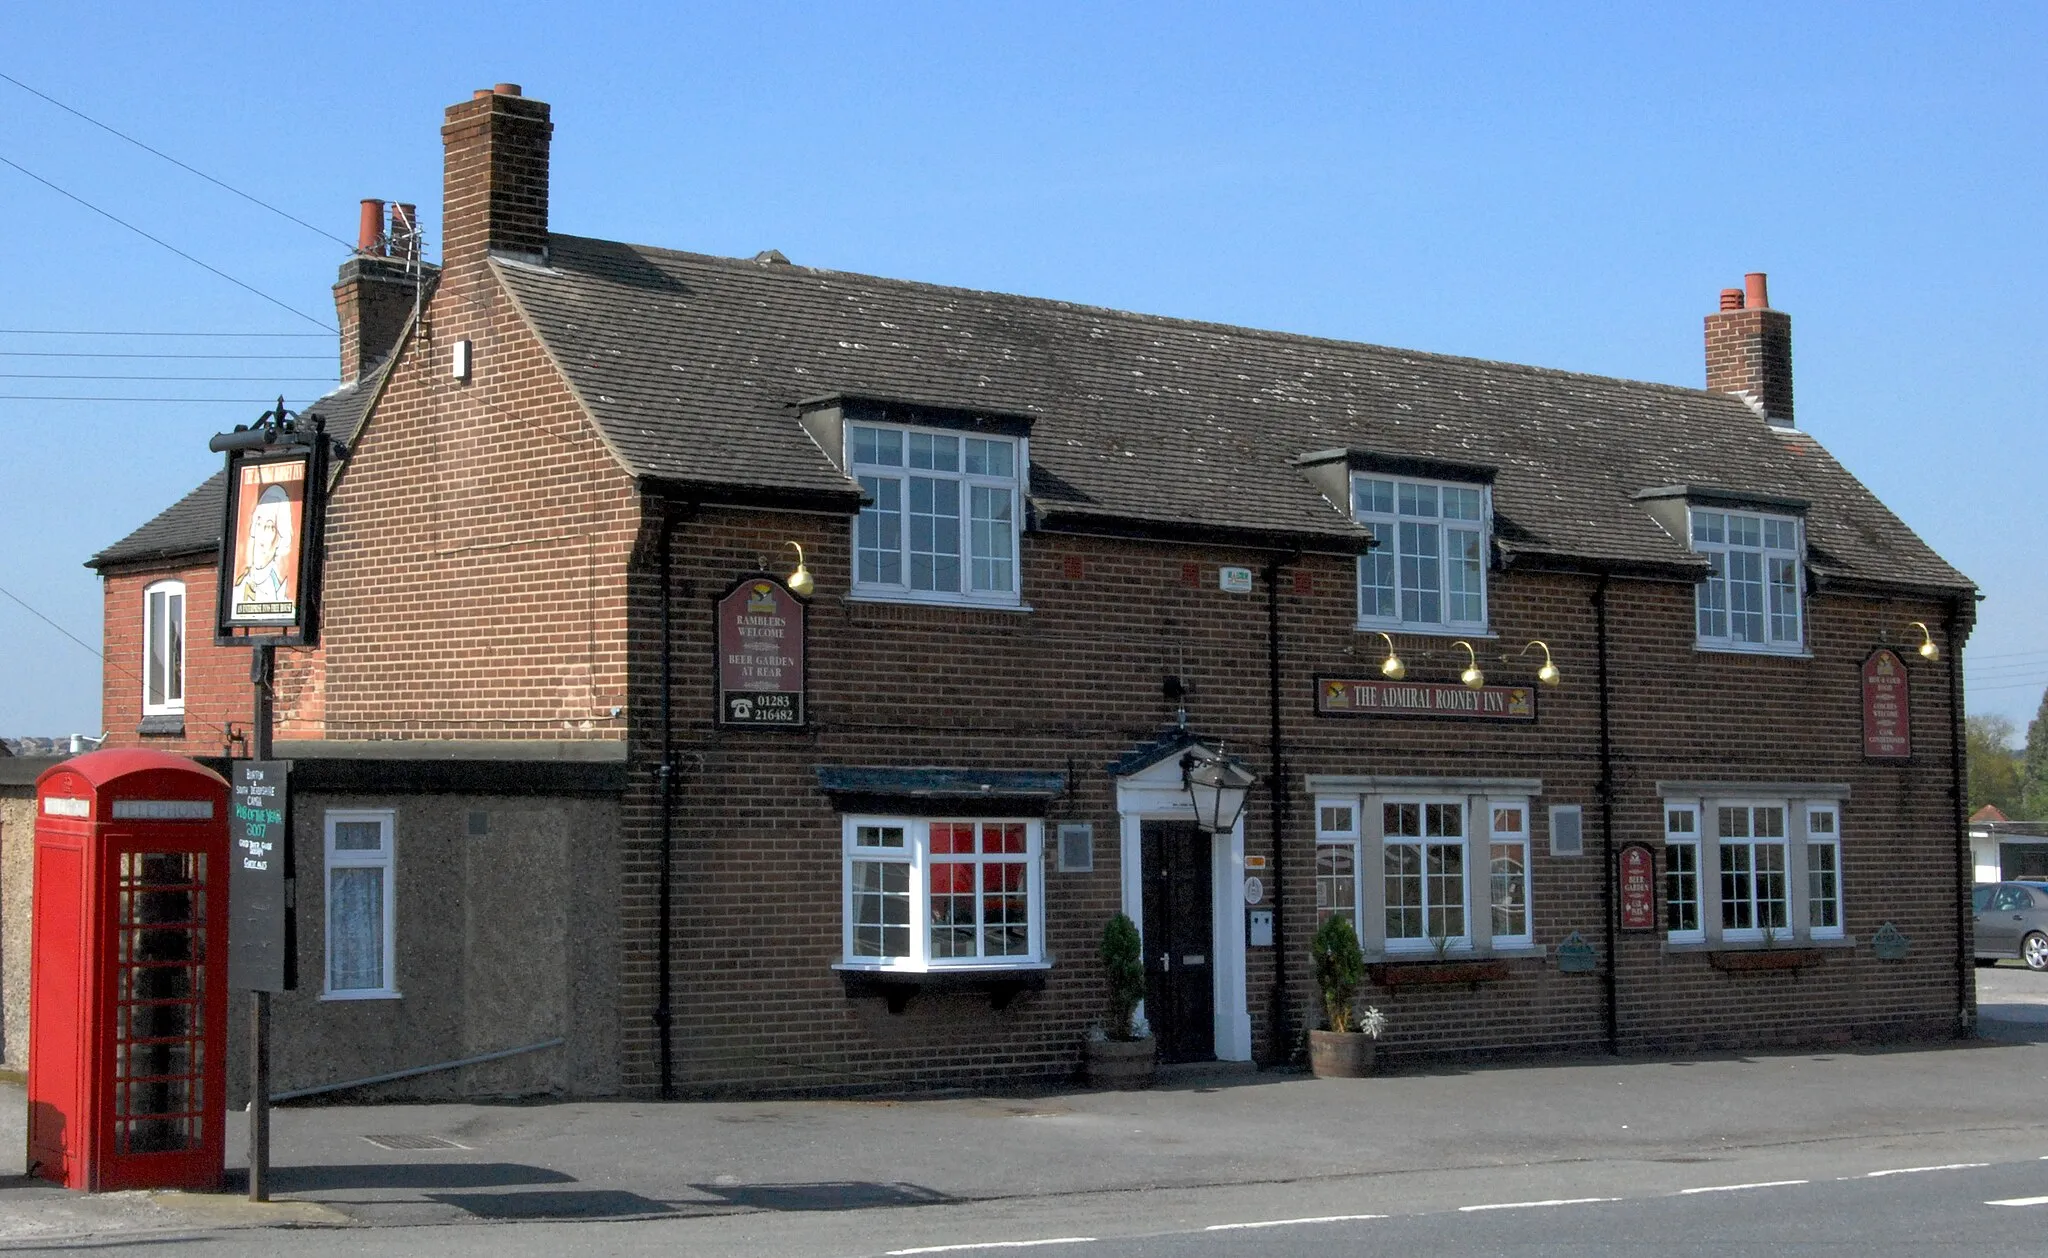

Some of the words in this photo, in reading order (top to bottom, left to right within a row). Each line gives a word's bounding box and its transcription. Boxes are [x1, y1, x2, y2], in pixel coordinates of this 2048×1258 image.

[737, 615, 786, 626] RAMBLERS
[738, 627, 785, 638] WELCOME
[729, 654, 753, 665] BEER
[756, 655, 794, 666] GARDEN
[742, 667, 753, 676] AT
[757, 667, 782, 677] REAR
[757, 695, 790, 707] 01283
[1354, 685, 1377, 707] THE
[1381, 687, 1431, 709] ADMIRAL
[1435, 689, 1480, 711] RODNEY
[1483, 691, 1504, 712] INN
[755, 709, 793, 721] 216482
[118, 802, 208, 817] TELEPHONE
[246, 823, 267, 838] 2007
[1625, 884, 1649, 892] GARDEN
